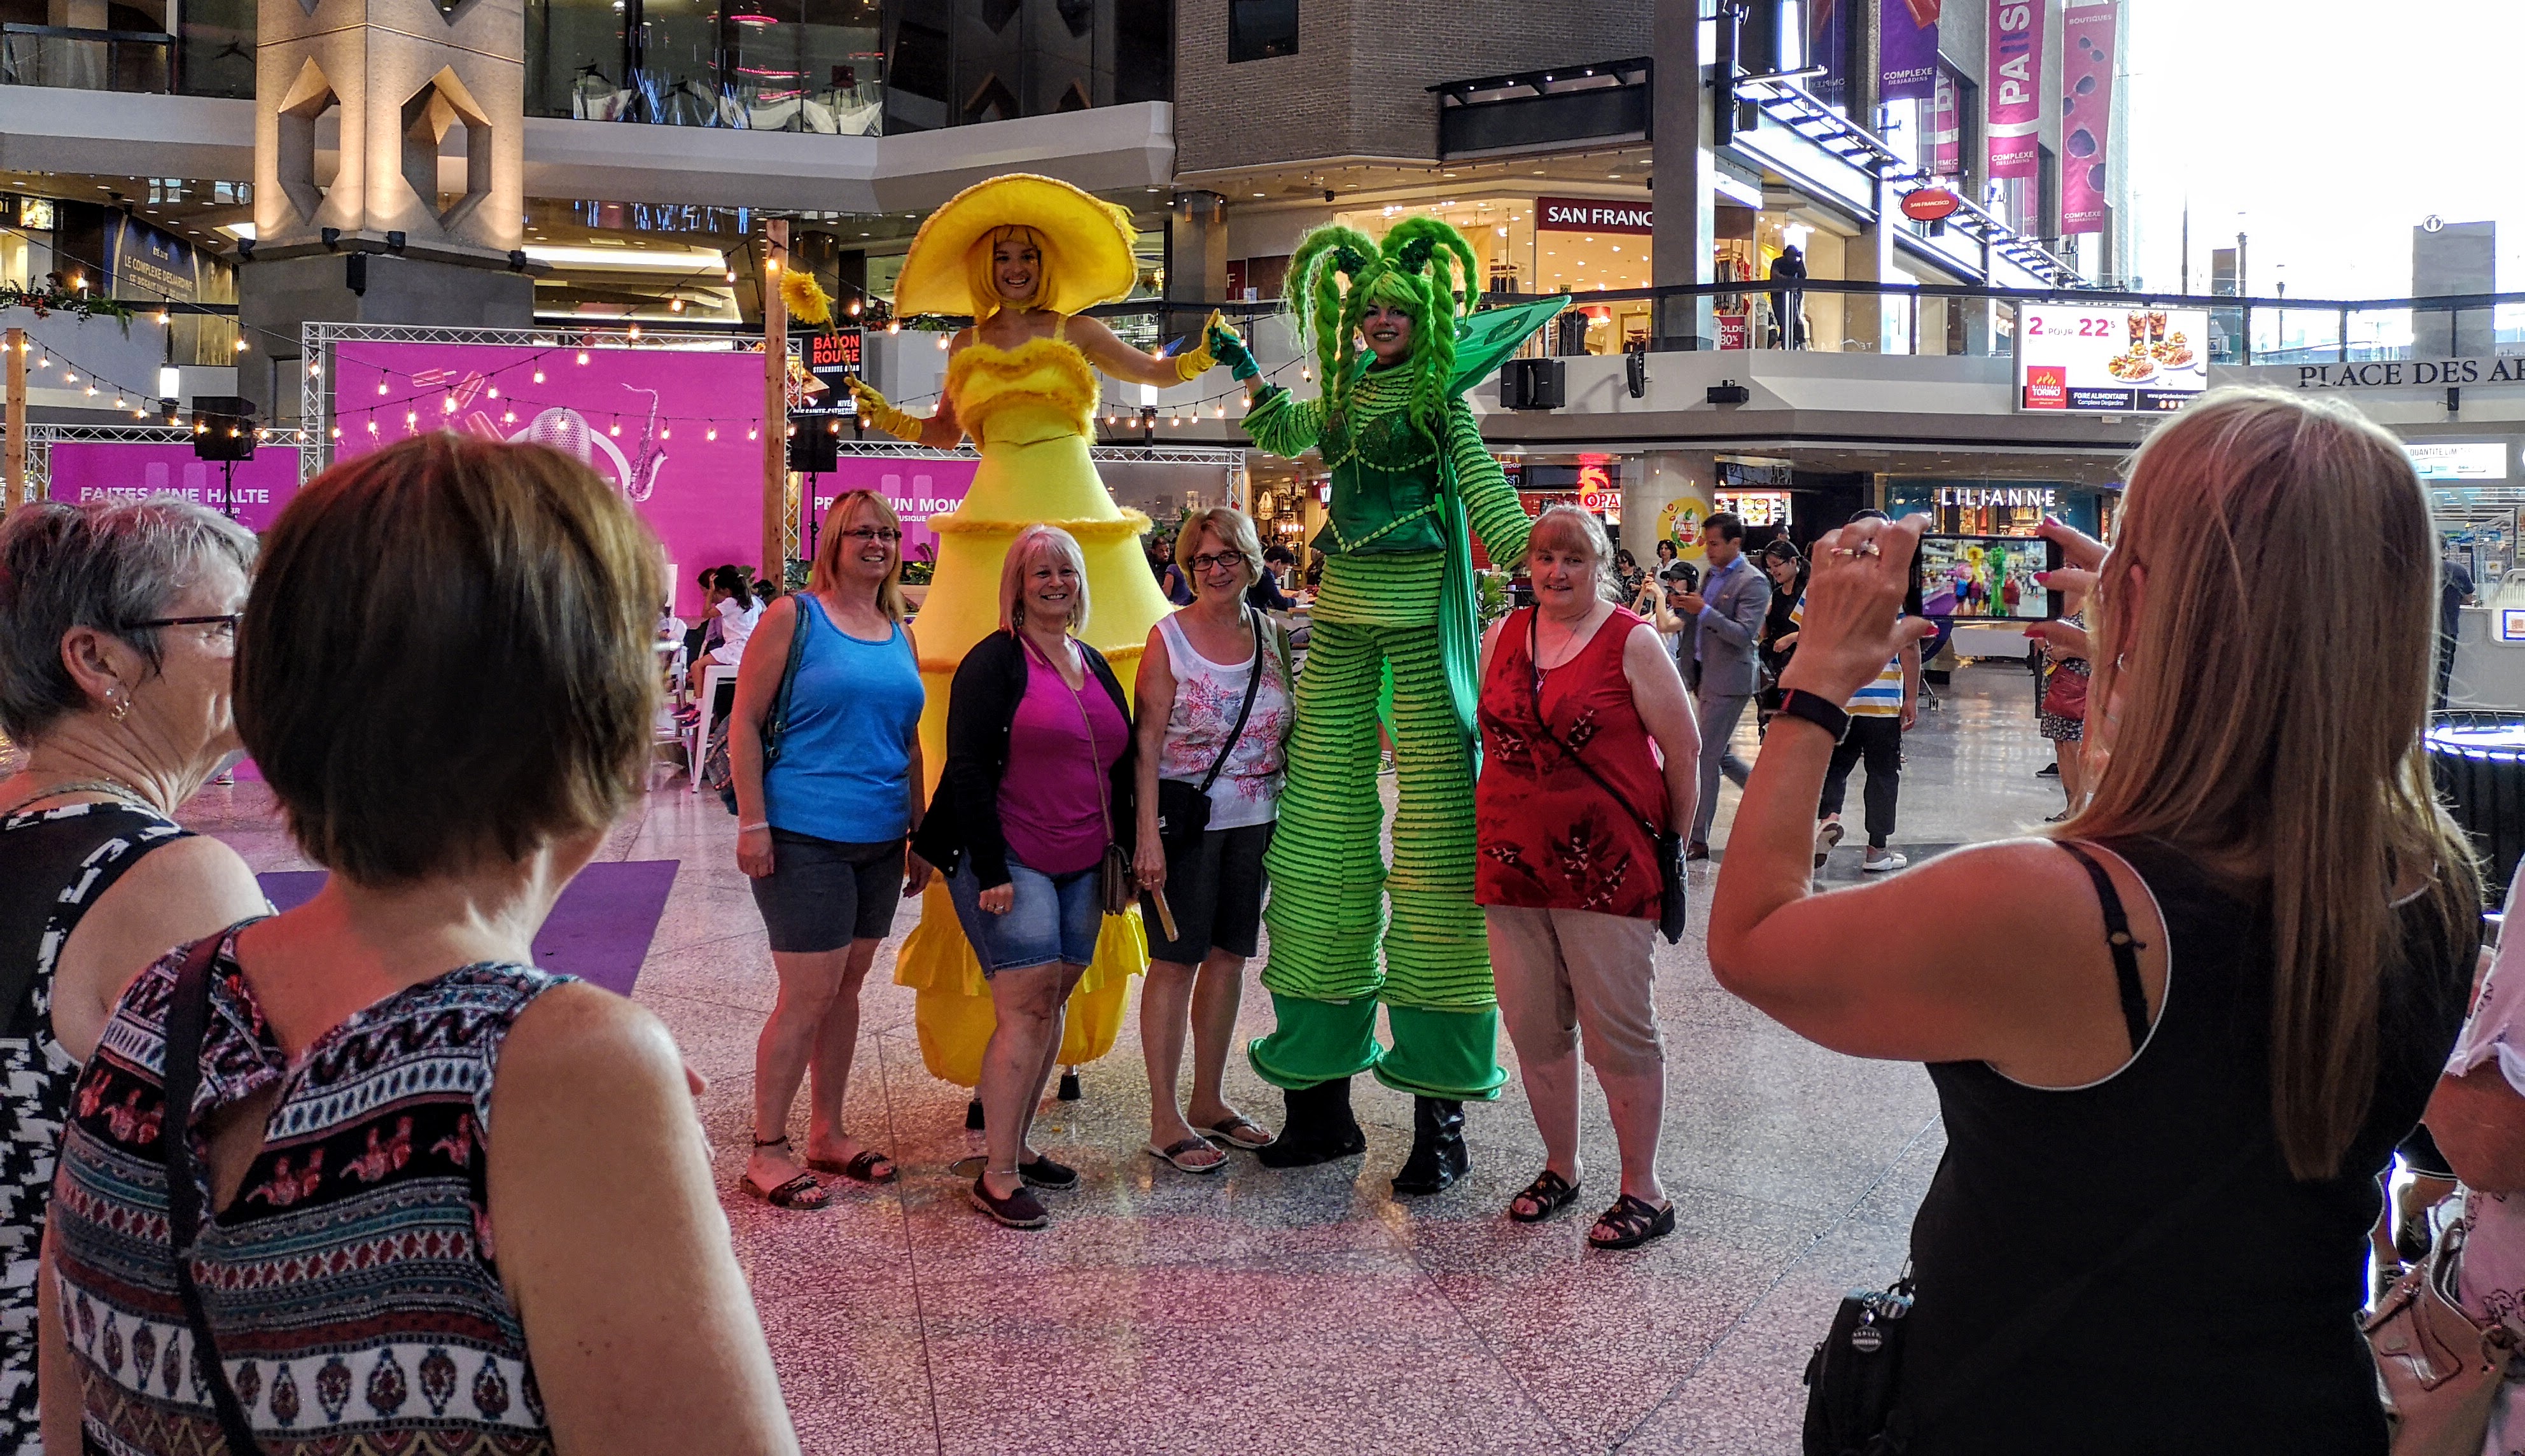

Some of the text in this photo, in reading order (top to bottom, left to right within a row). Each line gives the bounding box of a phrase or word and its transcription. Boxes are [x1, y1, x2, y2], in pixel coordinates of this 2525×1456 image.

[2069, 14, 2112, 25] BOUTIQUES
[1883, 67, 1933, 80] COMPLEXE
[1888, 76, 1928, 85] DESJARDINS
[1992, 151, 2034, 162] COMPLEXE
[1548, 206, 1586, 223] SAN
[2064, 211, 2101, 219] COMPLEXE
[124, 255, 193, 292] LE COMPLEXE DESJARDINS
[2029, 316, 2043, 335] 2
[2048, 328, 2073, 336] POUR
[813, 333, 860, 350] BÂTON
[813, 349, 860, 365] ROUGE
[813, 365, 843, 374] STEAKHOUSE
[2298, 363, 2402, 388] PLACE
[2412, 360, 2478, 385] DES
[2032, 388, 2061, 396] TORINO
[80, 486, 148, 502] FAITES
[207, 488, 269, 503] HALTE
[1584, 492, 1619, 508] OPA
[1942, 488, 2055, 507] LILIANNE
[888, 498, 913, 512] UN
